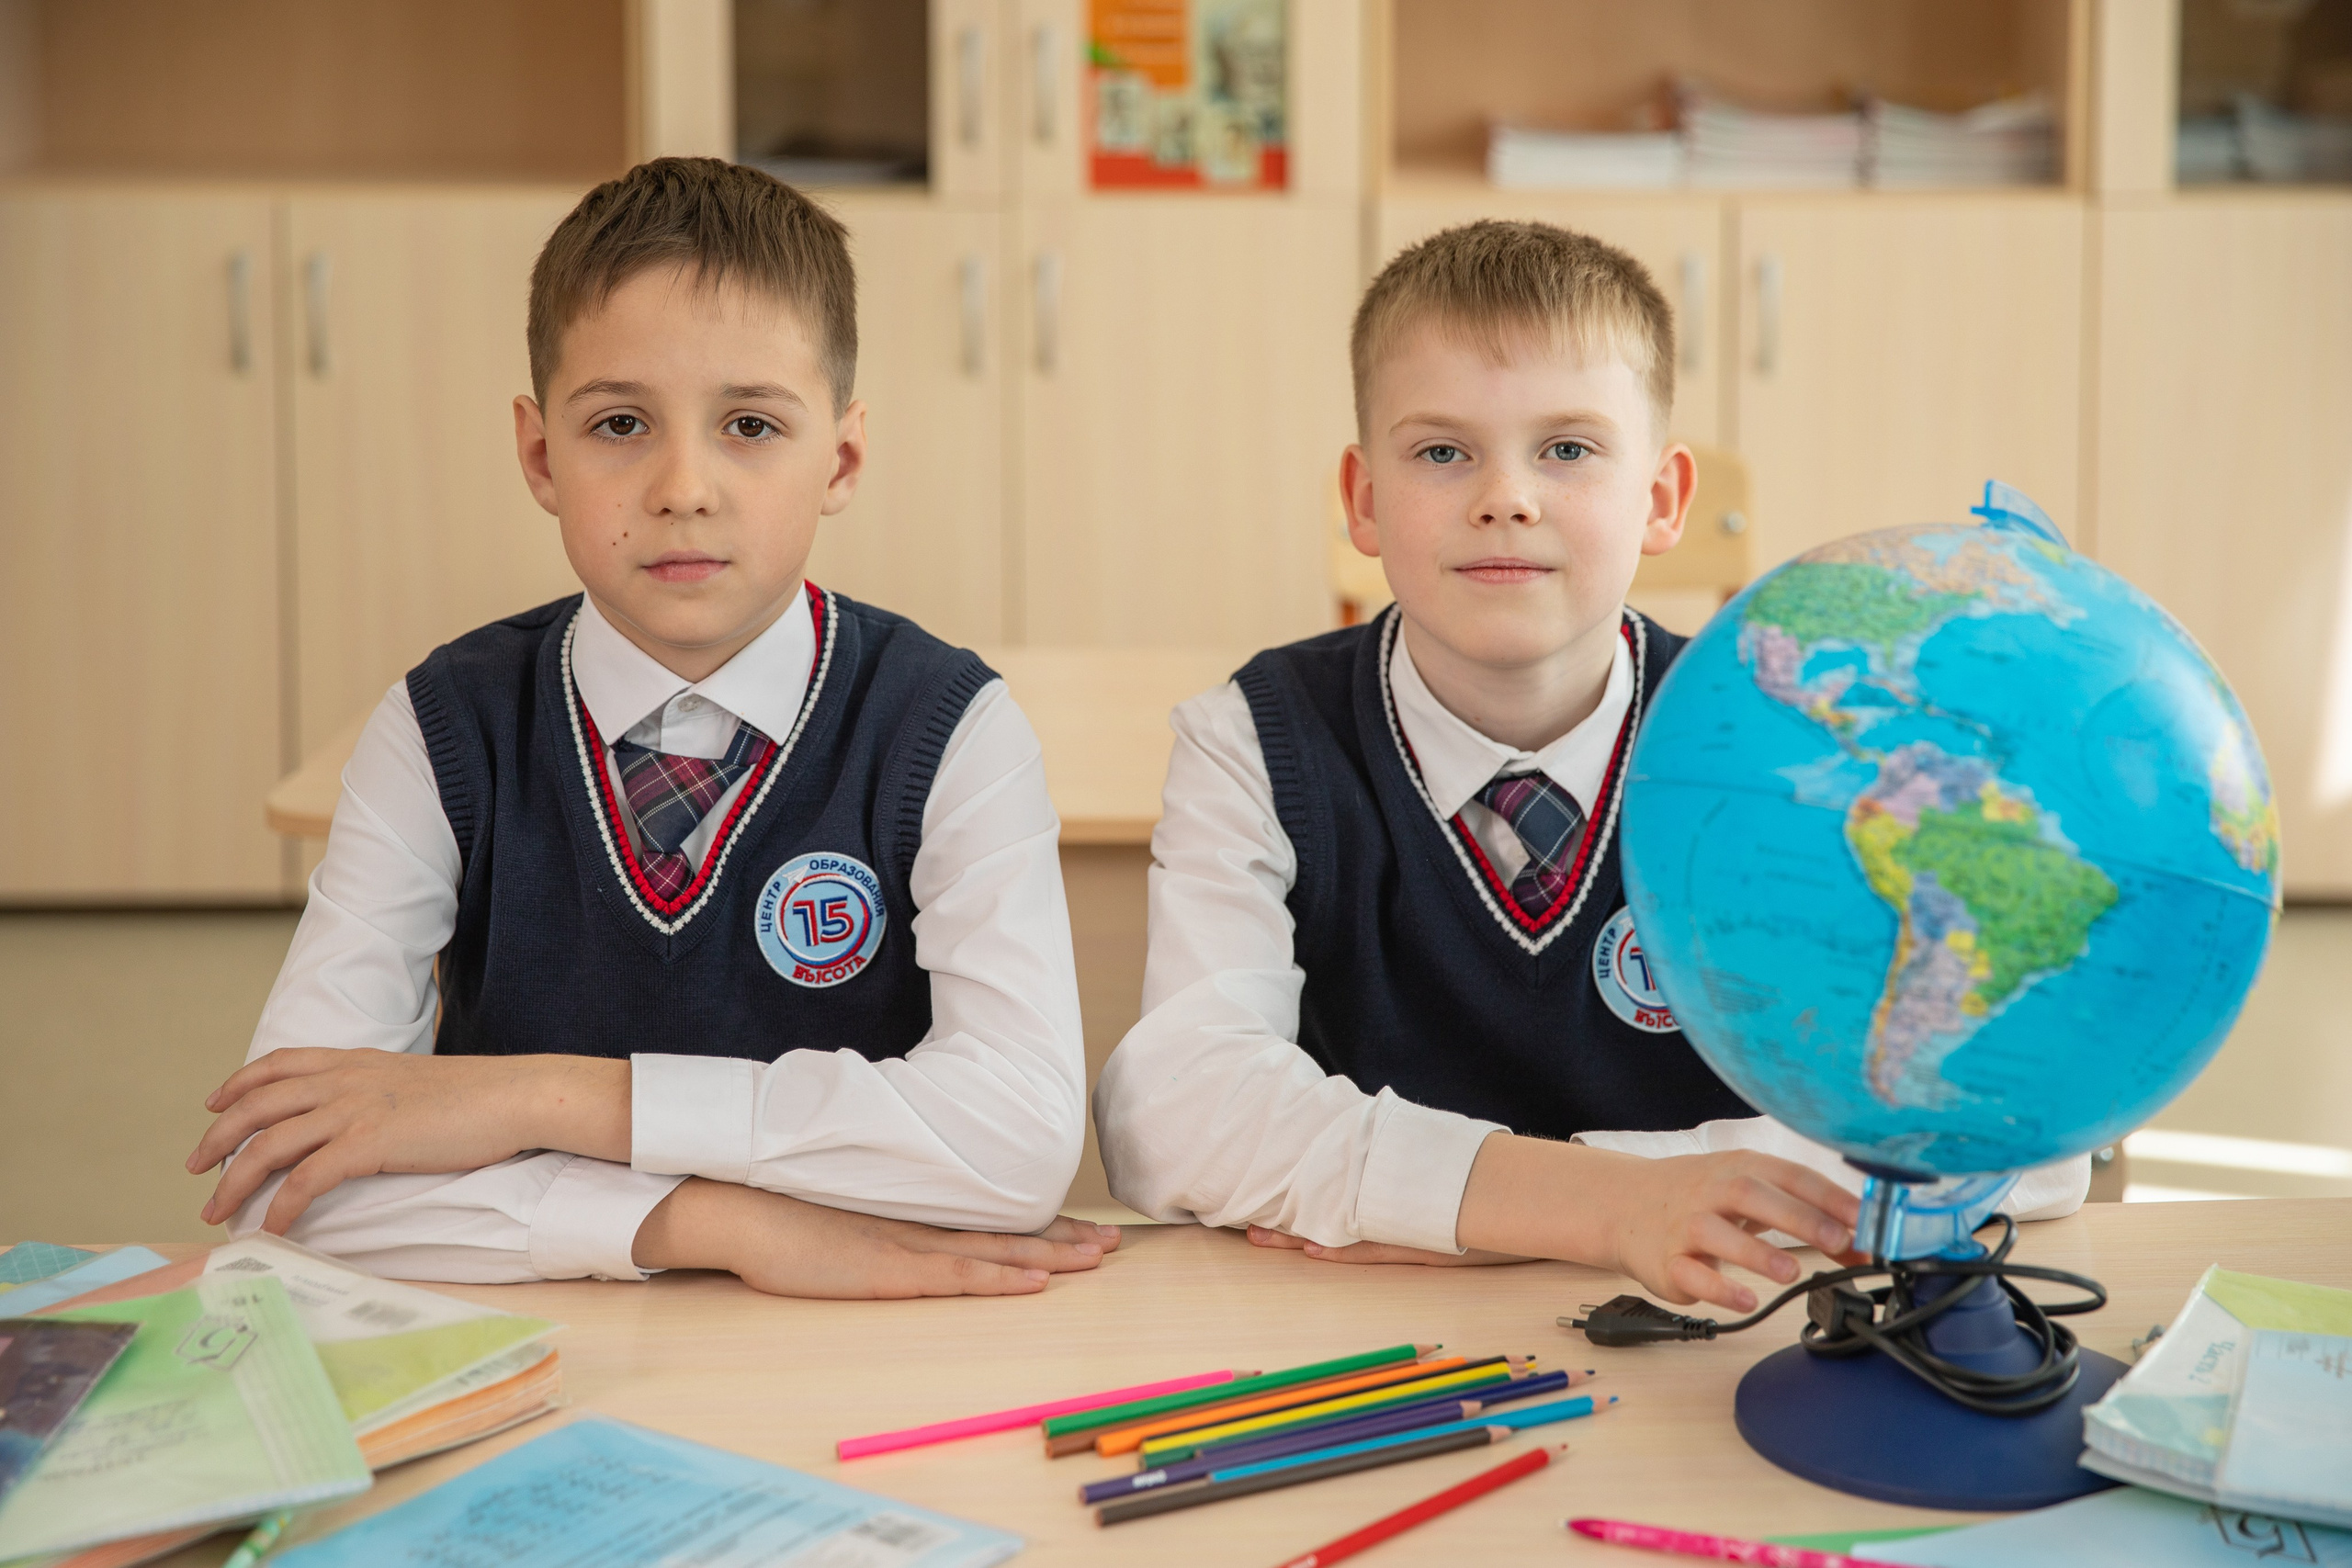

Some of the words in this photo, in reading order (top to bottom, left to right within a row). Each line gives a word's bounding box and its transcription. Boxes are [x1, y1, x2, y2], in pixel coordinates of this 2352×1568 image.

[761, 881, 782, 932] ЦЕНТР
[809, 859, 885, 917] ОБРАЗОВАНИЯ
[793, 895, 854, 947] 15
[792, 955, 866, 984] ВЫСОТА
[1599, 928, 1617, 979] ЦЕНТР
[1634, 1008, 1680, 1029] ВЫС
